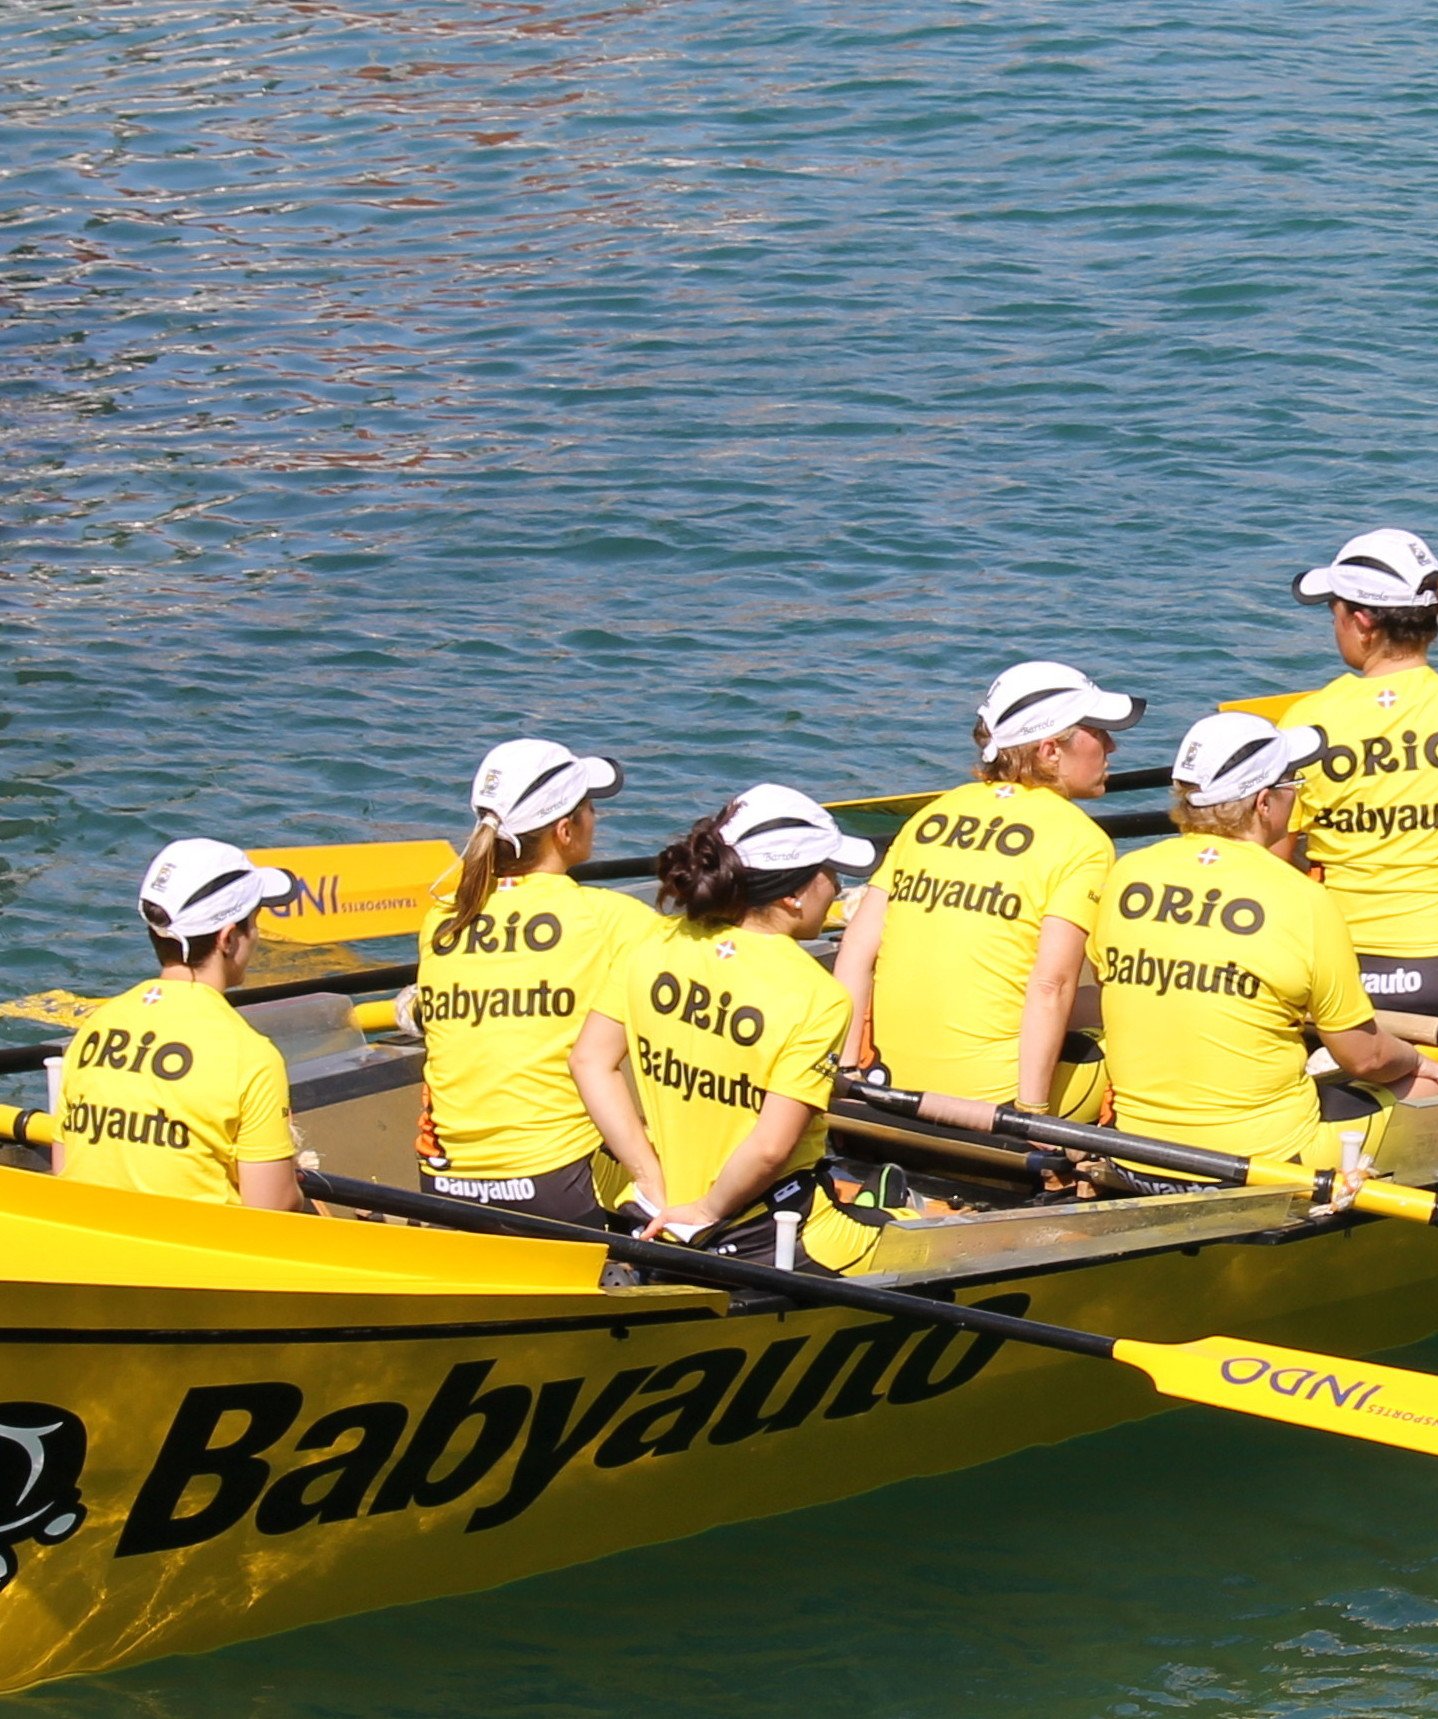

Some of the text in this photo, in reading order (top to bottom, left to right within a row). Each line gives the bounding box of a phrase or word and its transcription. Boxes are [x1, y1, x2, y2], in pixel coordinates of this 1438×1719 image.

[341, 897, 418, 913] TRANSPORTES
[888, 868, 1022, 921] Babyauto
[1104, 946, 1261, 1000] Babyauto
[420, 979, 576, 1028] Babyauto
[638, 1035, 767, 1115] Babyauto
[63, 1095, 190, 1149] abyauto
[1219, 1357, 1383, 1412] INDO
[113, 1291, 1032, 1559] Babyauto
